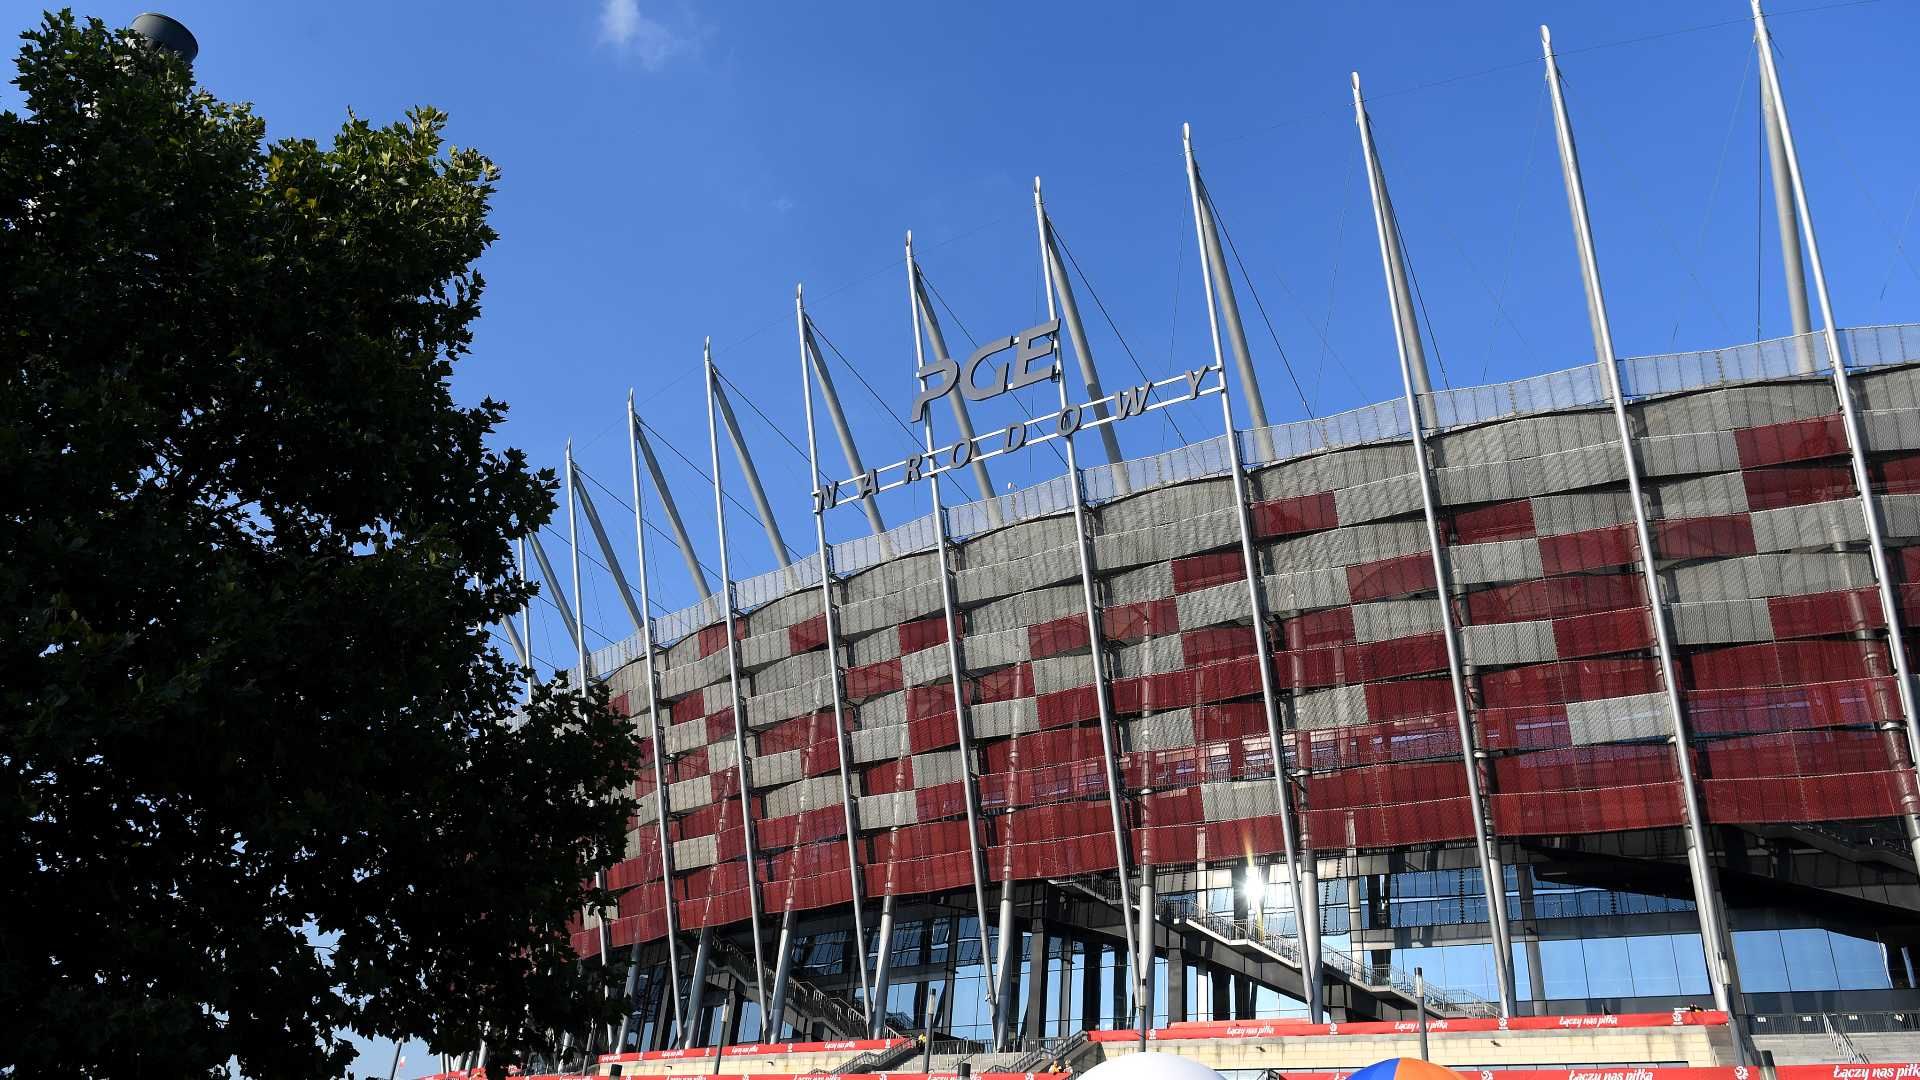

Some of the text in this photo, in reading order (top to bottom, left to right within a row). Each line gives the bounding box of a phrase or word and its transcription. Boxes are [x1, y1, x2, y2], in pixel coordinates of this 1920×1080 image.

[911, 318, 1061, 423] PGE
[815, 365, 1209, 512] NARODOWY
[1872, 1067, 1895, 1079] nas
[1895, 1063, 1920, 1080] piłk
